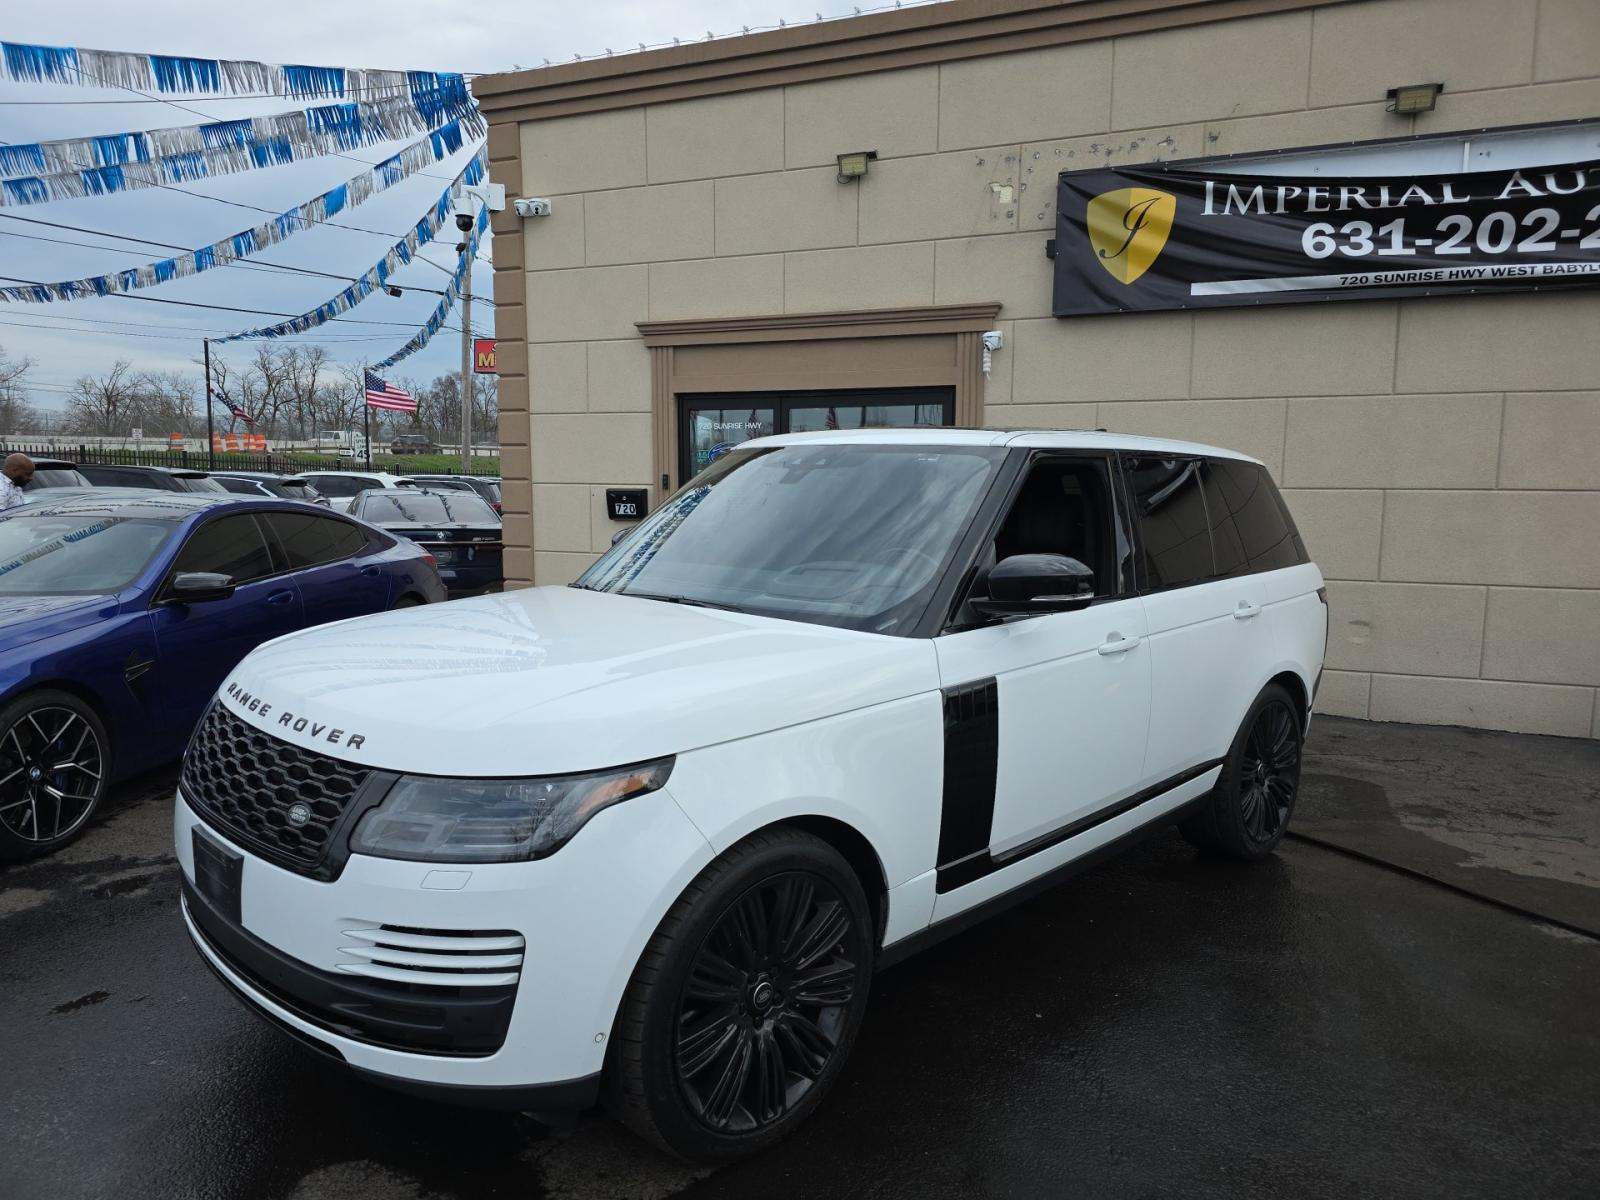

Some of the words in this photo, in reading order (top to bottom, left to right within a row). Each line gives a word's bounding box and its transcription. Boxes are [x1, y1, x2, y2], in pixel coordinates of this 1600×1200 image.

[1200, 180, 1471, 216] IMPERIAL
[1493, 167, 1600, 200] AU
[1340, 275, 1369, 286] 720
[1373, 270, 1444, 284] SUNRISE
[1449, 268, 1487, 280] HWY
[1491, 265, 1538, 277] WEST
[1542, 262, 1600, 275] BABYL
[714, 422, 743, 430] SUNRISE
[745, 422, 762, 430] HWY
[616, 504, 636, 514] 720
[227, 682, 272, 717] RANGE
[278, 712, 366, 750] ROVER
